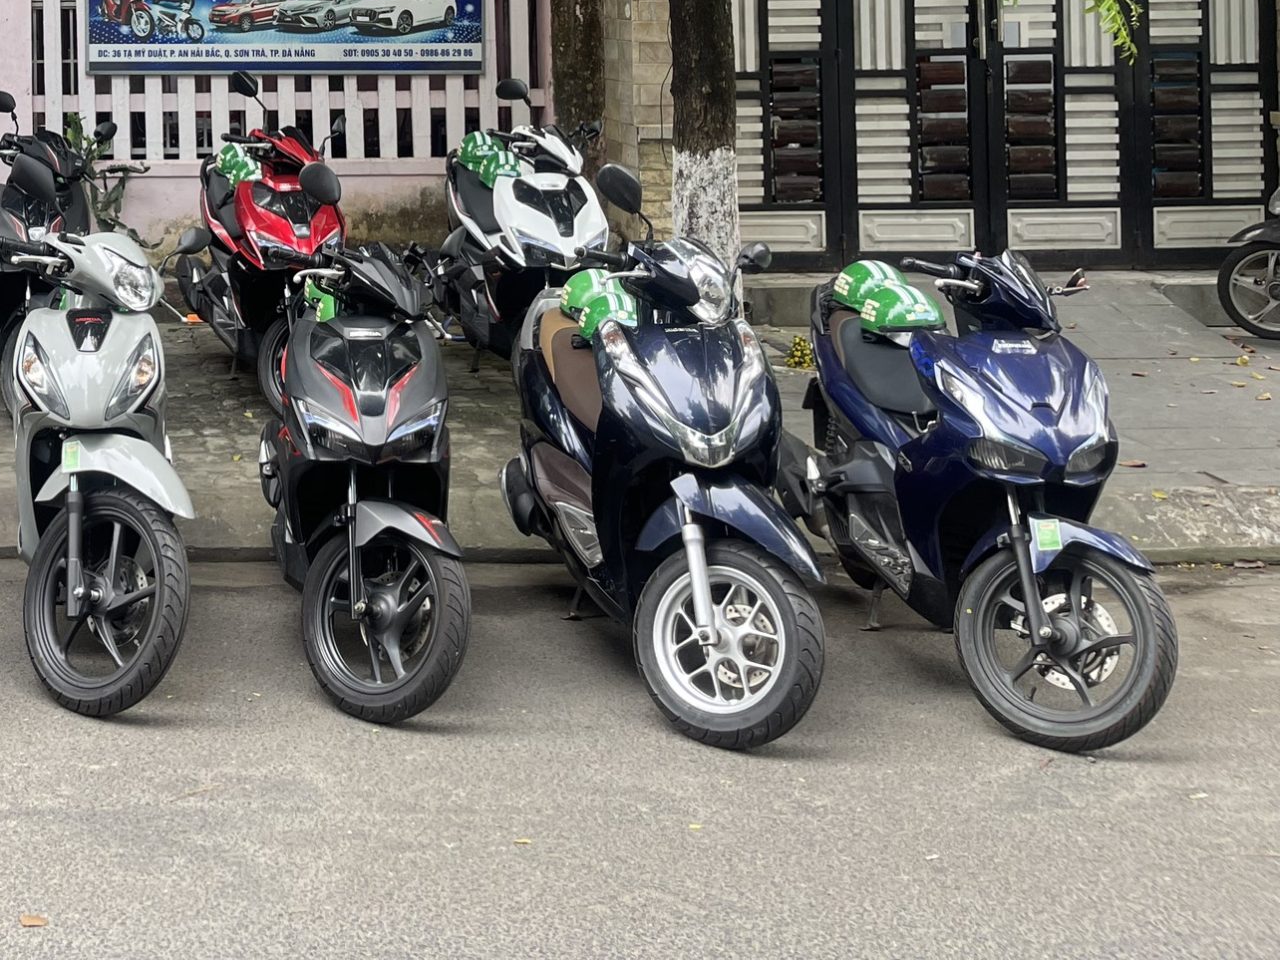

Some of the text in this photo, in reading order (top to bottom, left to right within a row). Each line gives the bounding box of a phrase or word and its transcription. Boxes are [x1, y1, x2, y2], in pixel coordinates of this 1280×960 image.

[178, 49, 189, 58] AN
[190, 47, 203, 58] HẢI
[234, 49, 249, 58] SƠN
[360, 49, 380, 58] 0905
[381, 49, 391, 58] 30
[392, 49, 402, 58] 40
[404, 49, 414, 58] 50
[452, 49, 462, 58] 29
